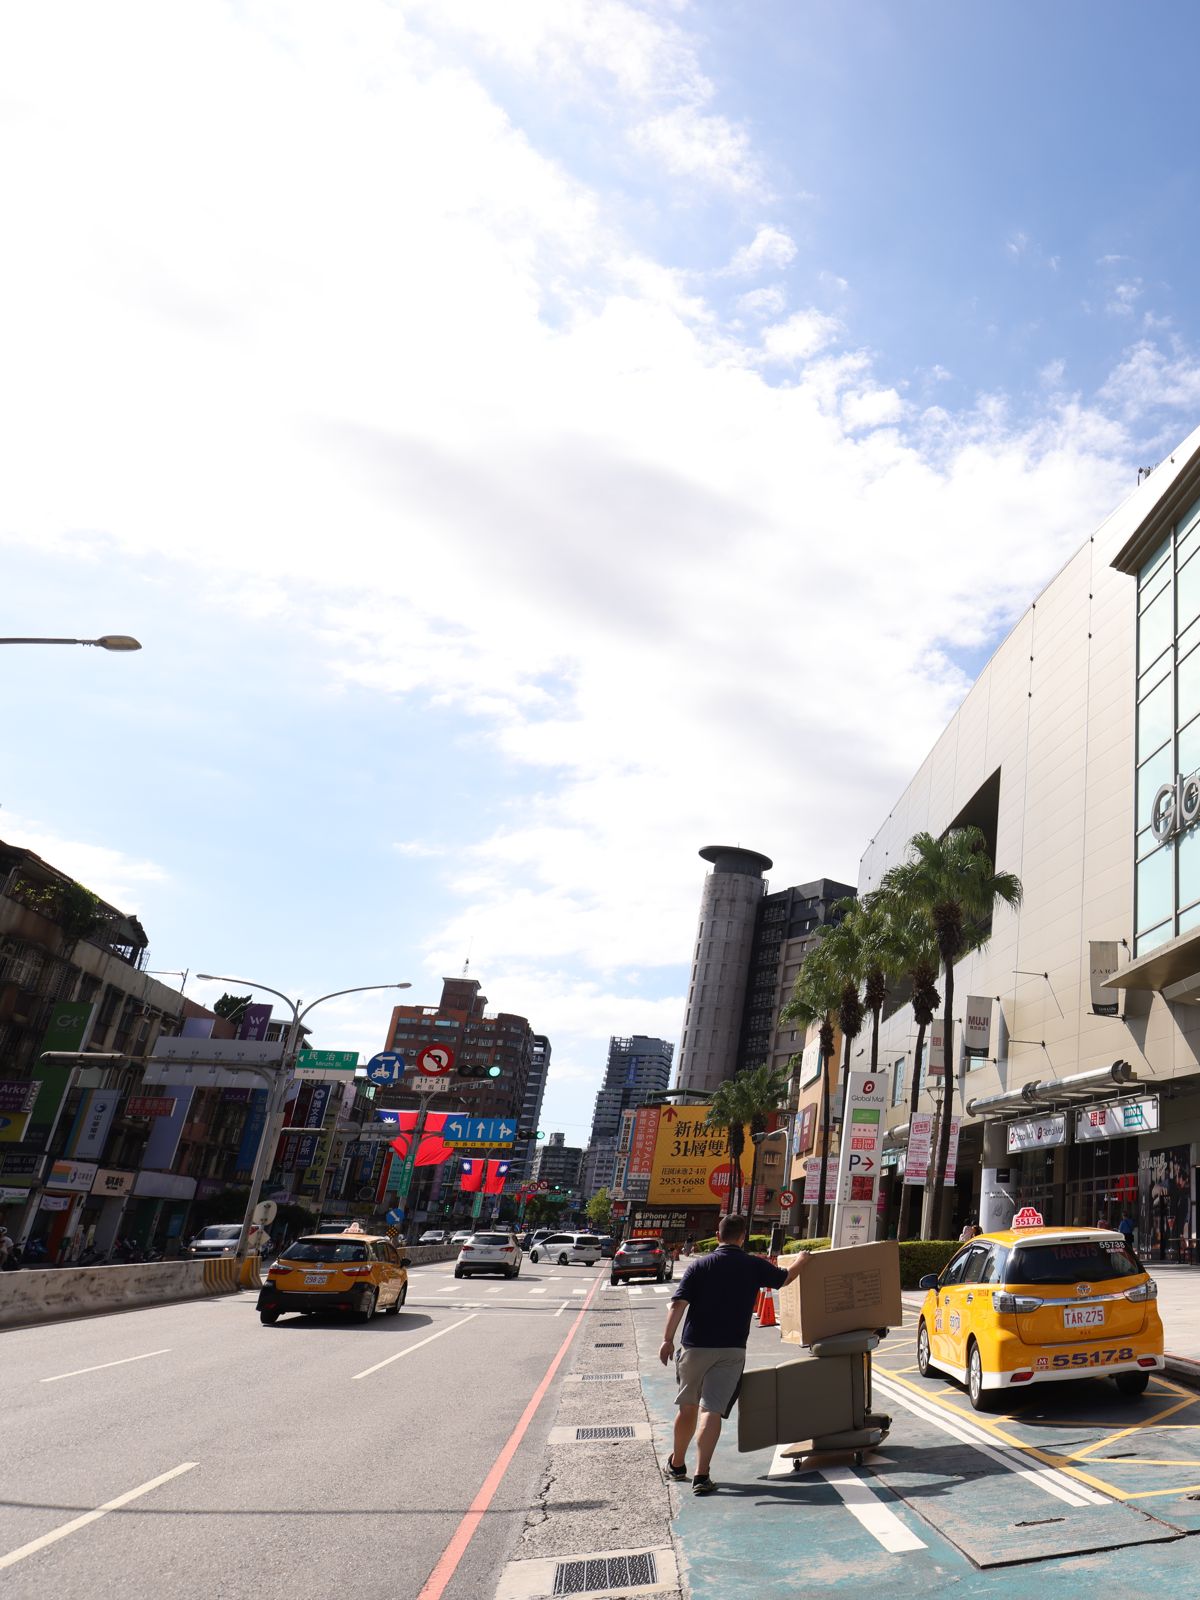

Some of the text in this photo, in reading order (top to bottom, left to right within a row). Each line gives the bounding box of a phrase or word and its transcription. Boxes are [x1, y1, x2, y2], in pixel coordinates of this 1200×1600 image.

[968, 1015, 989, 1027] MUJI
[308, 1051, 353, 1062] 民治街
[851, 1094, 871, 1102] Global
[849, 1154, 861, 1171] P
[643, 1212, 667, 1220] iPhone
[672, 1212, 687, 1220] iPad
[1015, 1217, 1042, 1226] 55178
[1064, 1310, 1104, 1326] TAR-275
[1052, 1347, 1134, 1367] 55178
